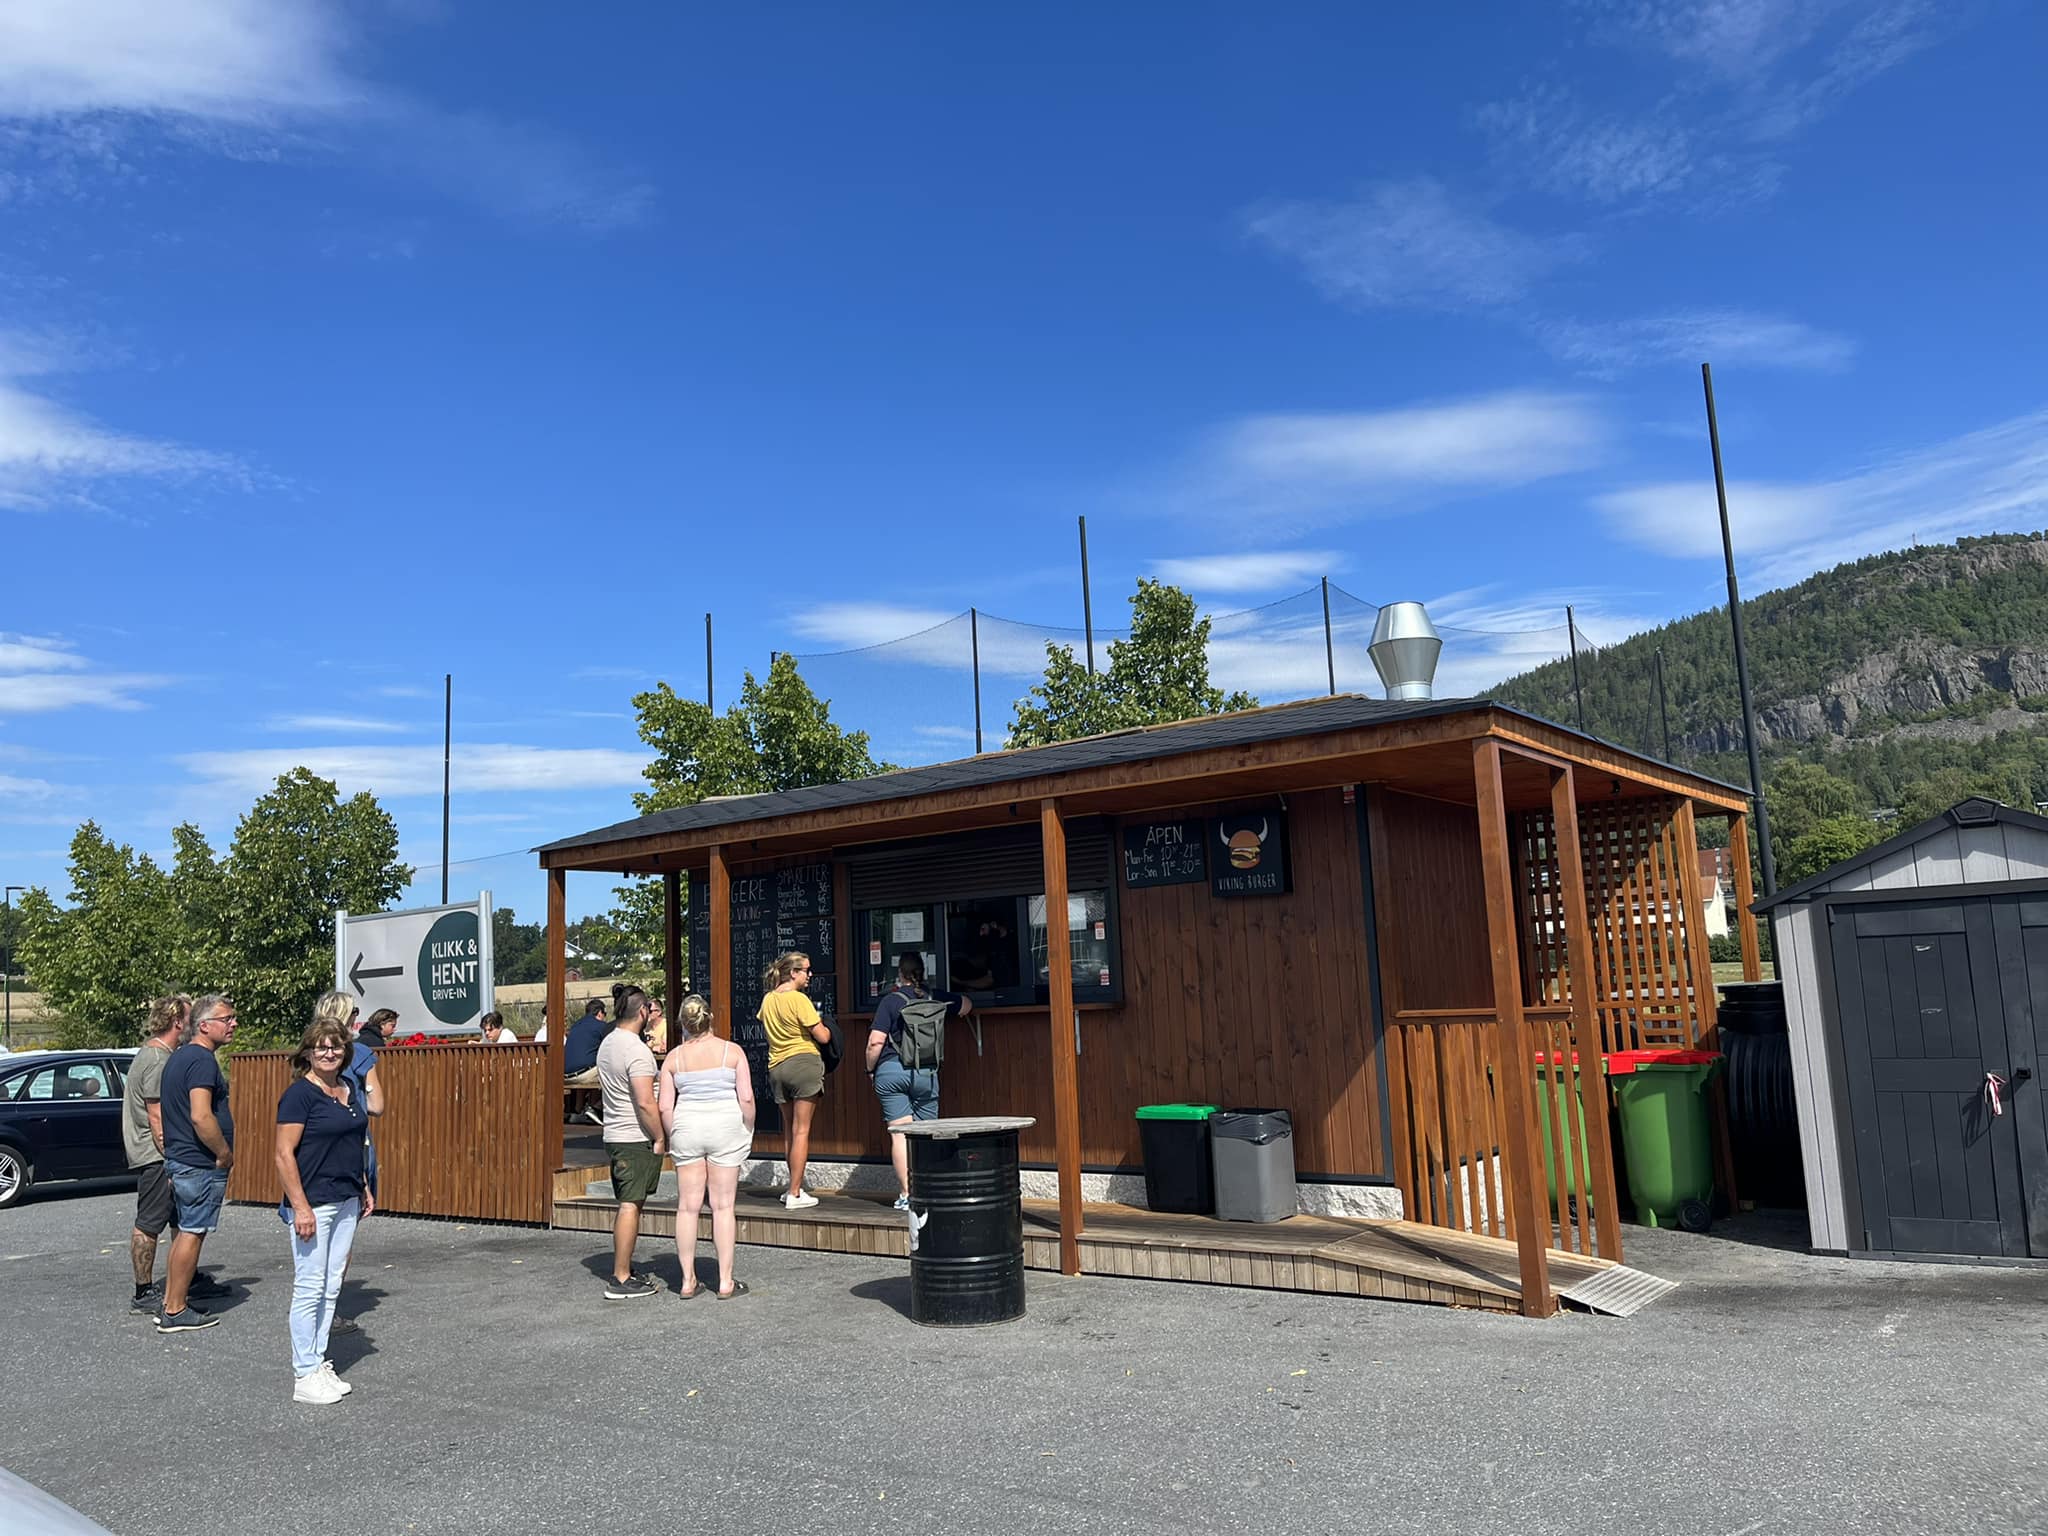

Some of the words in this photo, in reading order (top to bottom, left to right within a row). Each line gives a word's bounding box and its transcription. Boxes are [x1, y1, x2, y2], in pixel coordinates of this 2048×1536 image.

[1145, 825, 1183, 846] ÅPEN
[703, 879, 767, 906] BGERE
[1217, 876, 1245, 891] VIKING
[1247, 873, 1276, 889] BURGER
[432, 940, 465, 959] KLIKK
[468, 938, 478, 956] &
[432, 960, 478, 986] HENT
[432, 987, 468, 1001] DRIVE-IN
[741, 1024, 766, 1042] VIKIN
